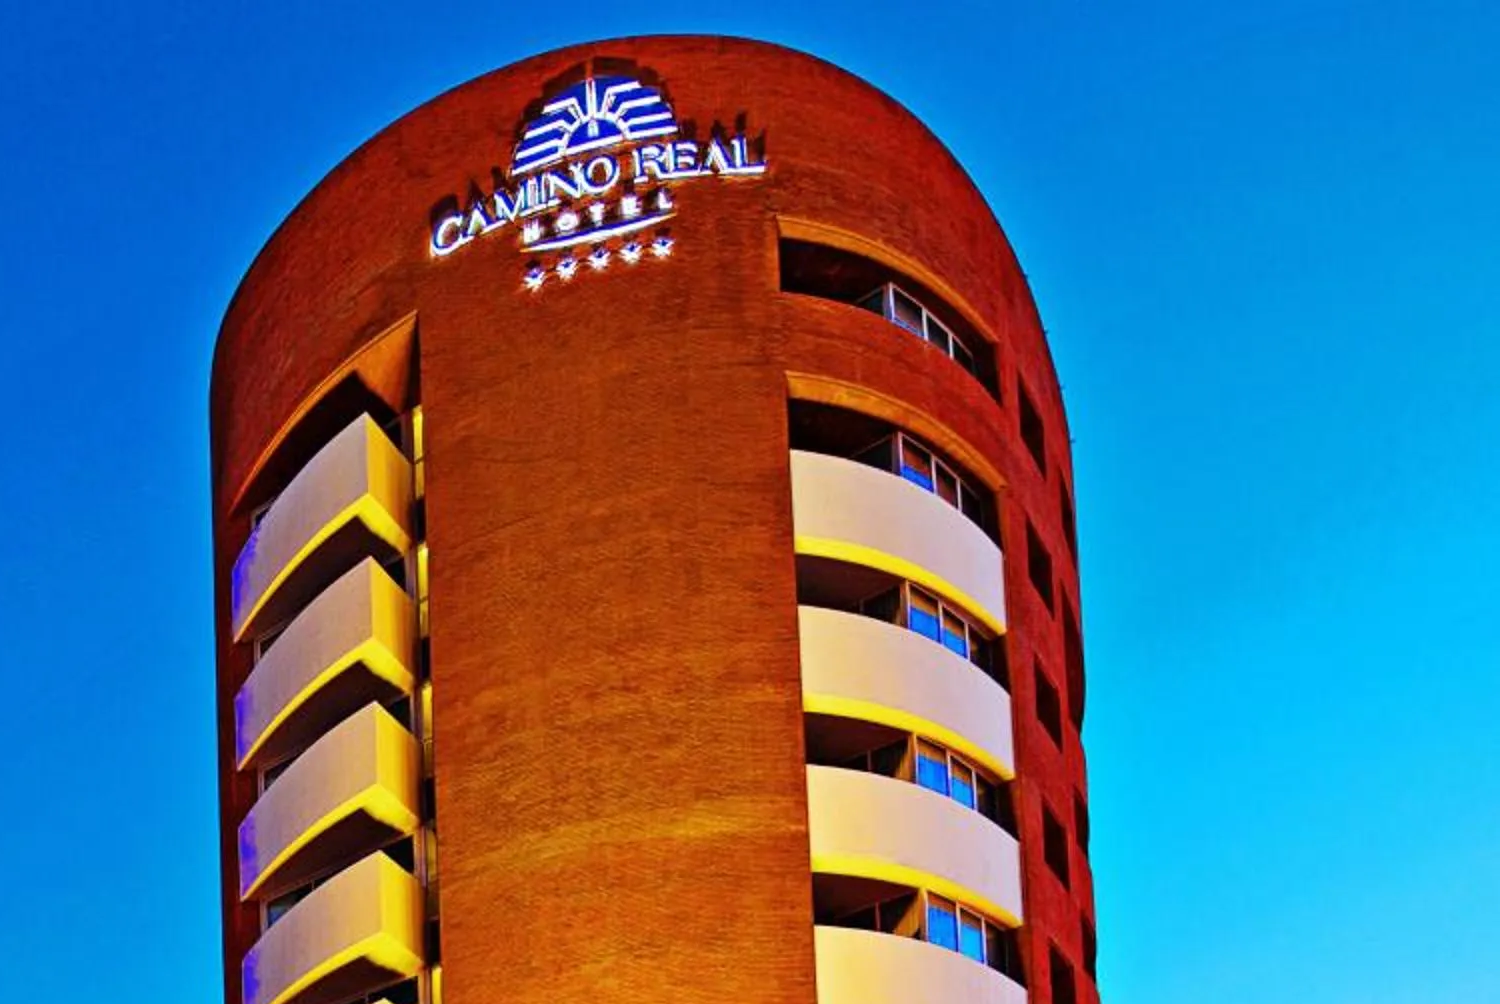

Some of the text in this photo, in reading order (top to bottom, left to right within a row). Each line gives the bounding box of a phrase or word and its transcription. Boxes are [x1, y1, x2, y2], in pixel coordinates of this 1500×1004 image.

[430, 132, 767, 256] CAMINO REAL
[522, 189, 674, 243] HOTEL
